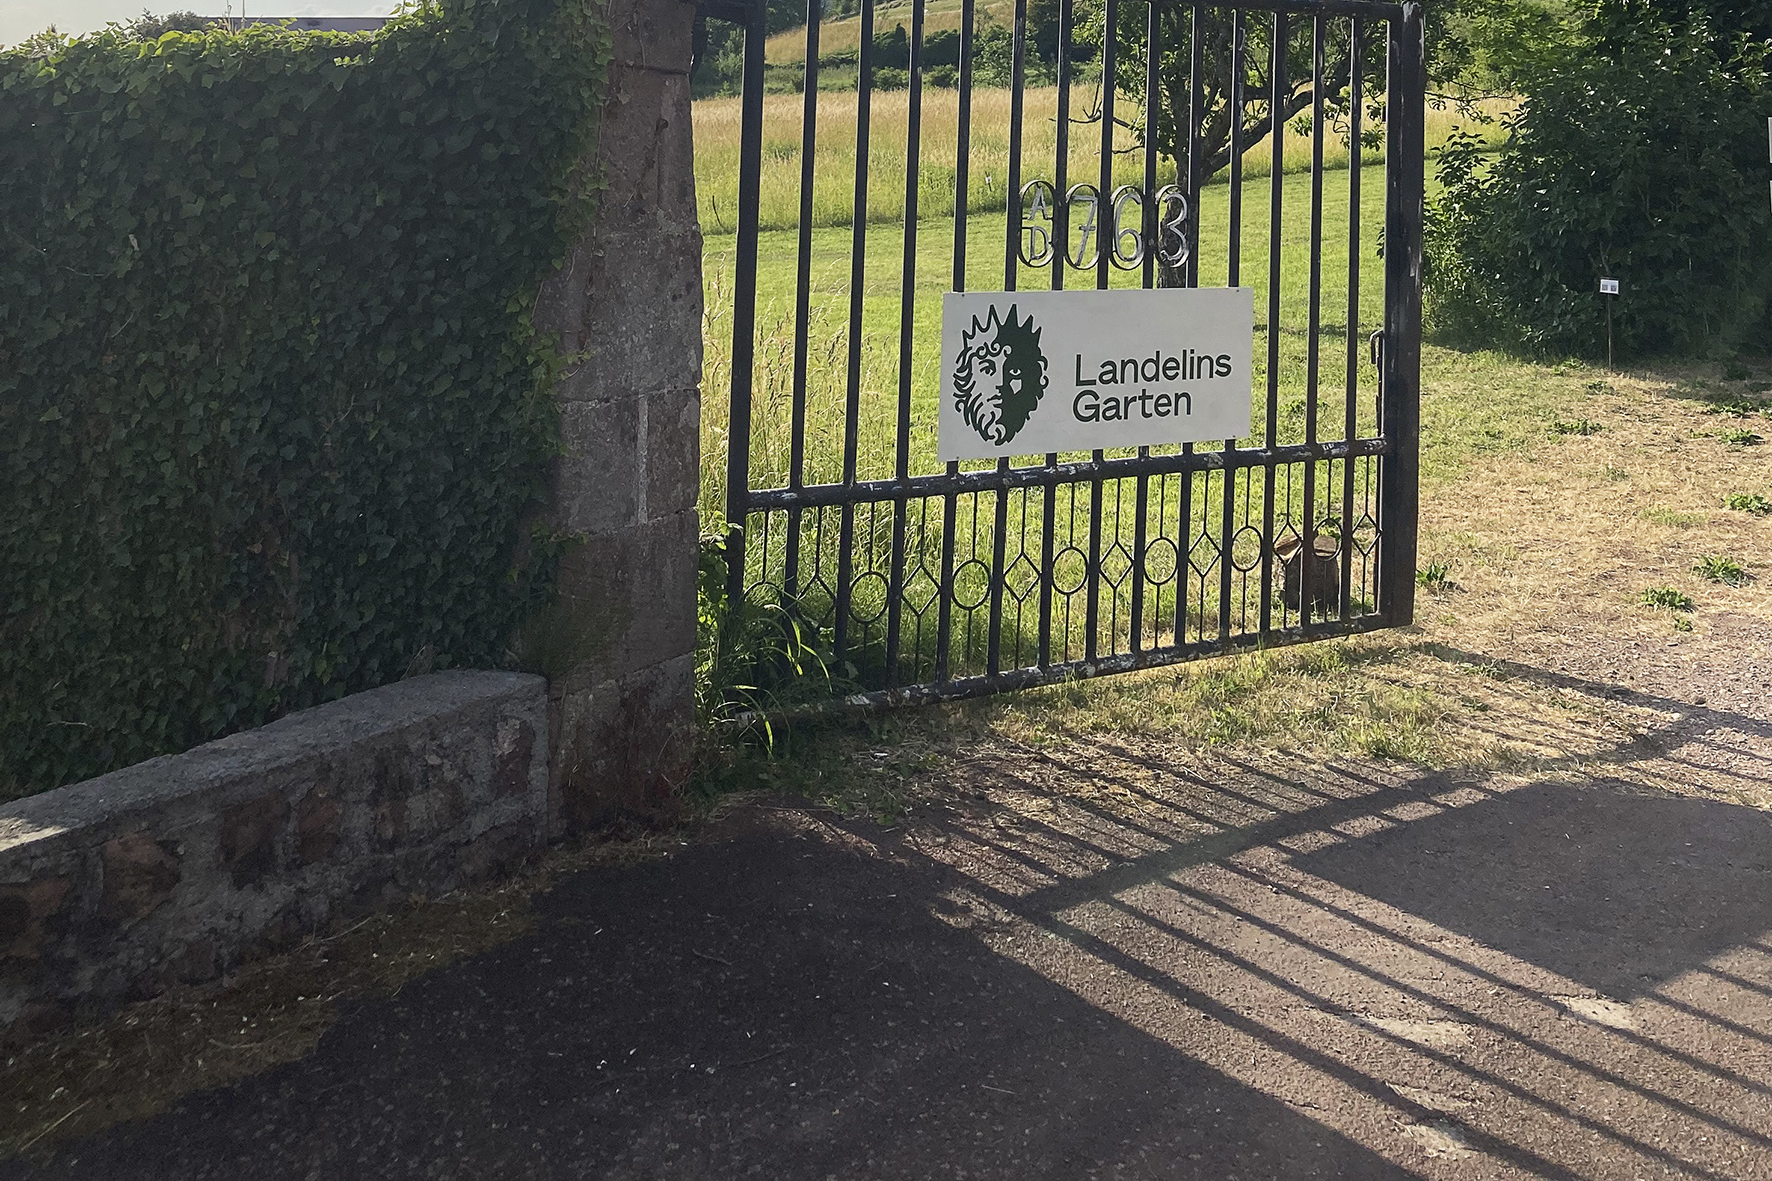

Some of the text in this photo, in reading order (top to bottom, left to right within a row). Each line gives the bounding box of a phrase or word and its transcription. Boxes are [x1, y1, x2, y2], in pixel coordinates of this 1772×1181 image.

[1069, 192, 1188, 267] 763
[1075, 349, 1233, 387] Landelins
[1072, 388, 1192, 423] Garten
